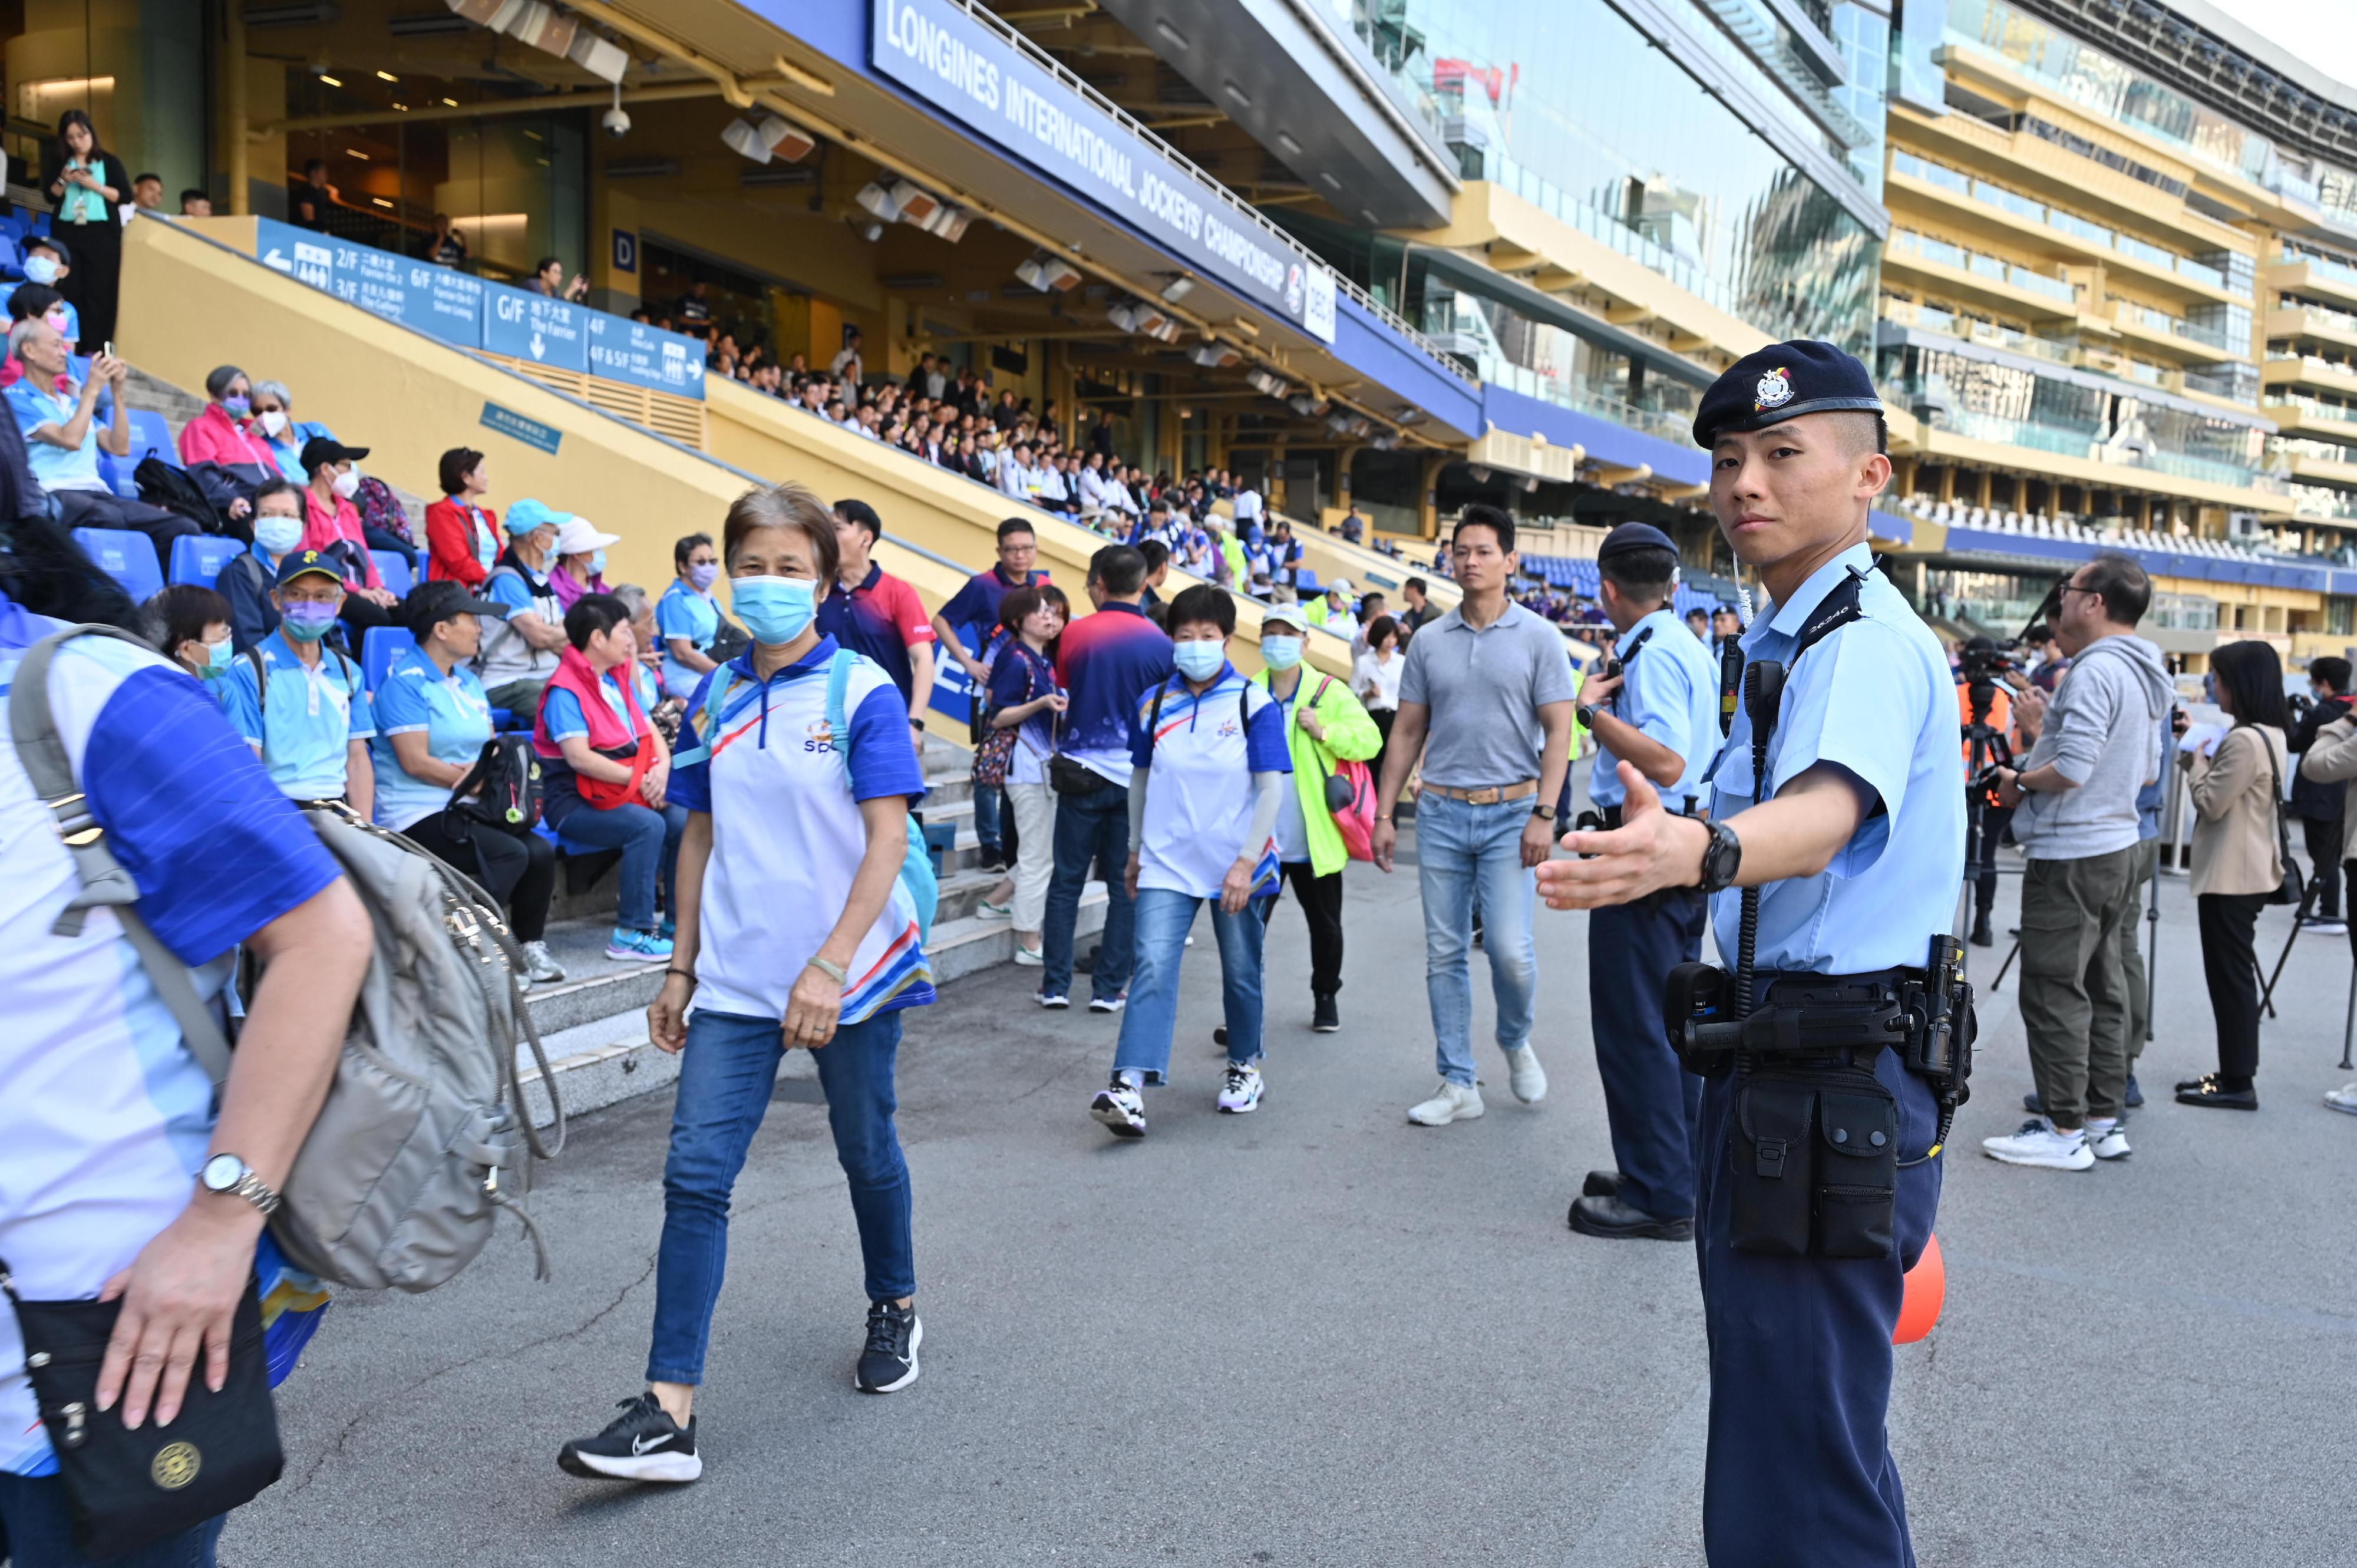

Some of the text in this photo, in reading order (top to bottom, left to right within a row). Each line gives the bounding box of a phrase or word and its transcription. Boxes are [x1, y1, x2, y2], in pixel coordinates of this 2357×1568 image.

[887, 0, 1285, 293] LONGINES INTERNATIONAL JOCKEYS' CHAMPIONSHIP
[336, 247, 359, 270] 2/F
[618, 237, 632, 265] D
[336, 278, 358, 300] 3/F
[411, 268, 431, 289] 6/F
[497, 295, 524, 323] G/F
[530, 301, 571, 324] 地下大堂
[530, 317, 577, 341] The Farrier
[1808, 605, 1848, 635] 26246
